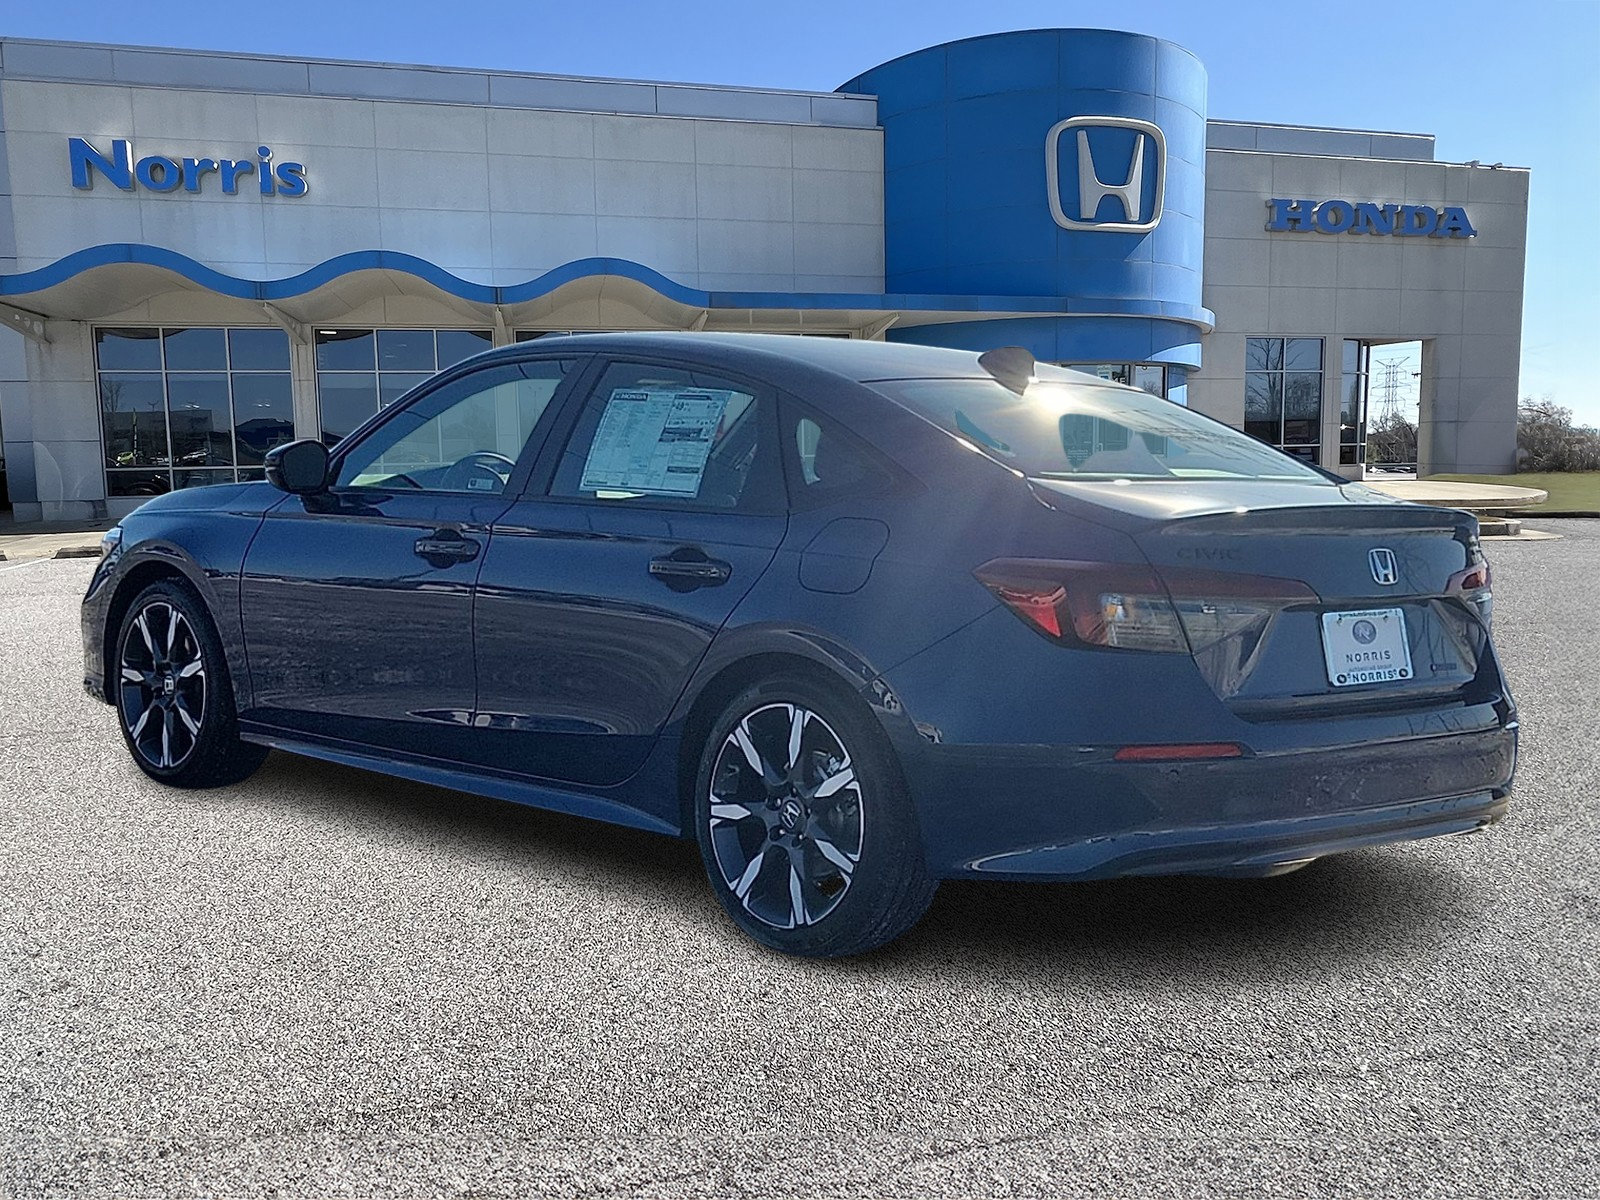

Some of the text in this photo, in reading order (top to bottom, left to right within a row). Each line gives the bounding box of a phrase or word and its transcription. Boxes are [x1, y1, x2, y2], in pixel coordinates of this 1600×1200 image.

[68, 137, 308, 197] Norris
[1265, 198, 1477, 239] HONDA
[1346, 650, 1391, 663] NORRIS
[1352, 670, 1394, 683] NORRIS
